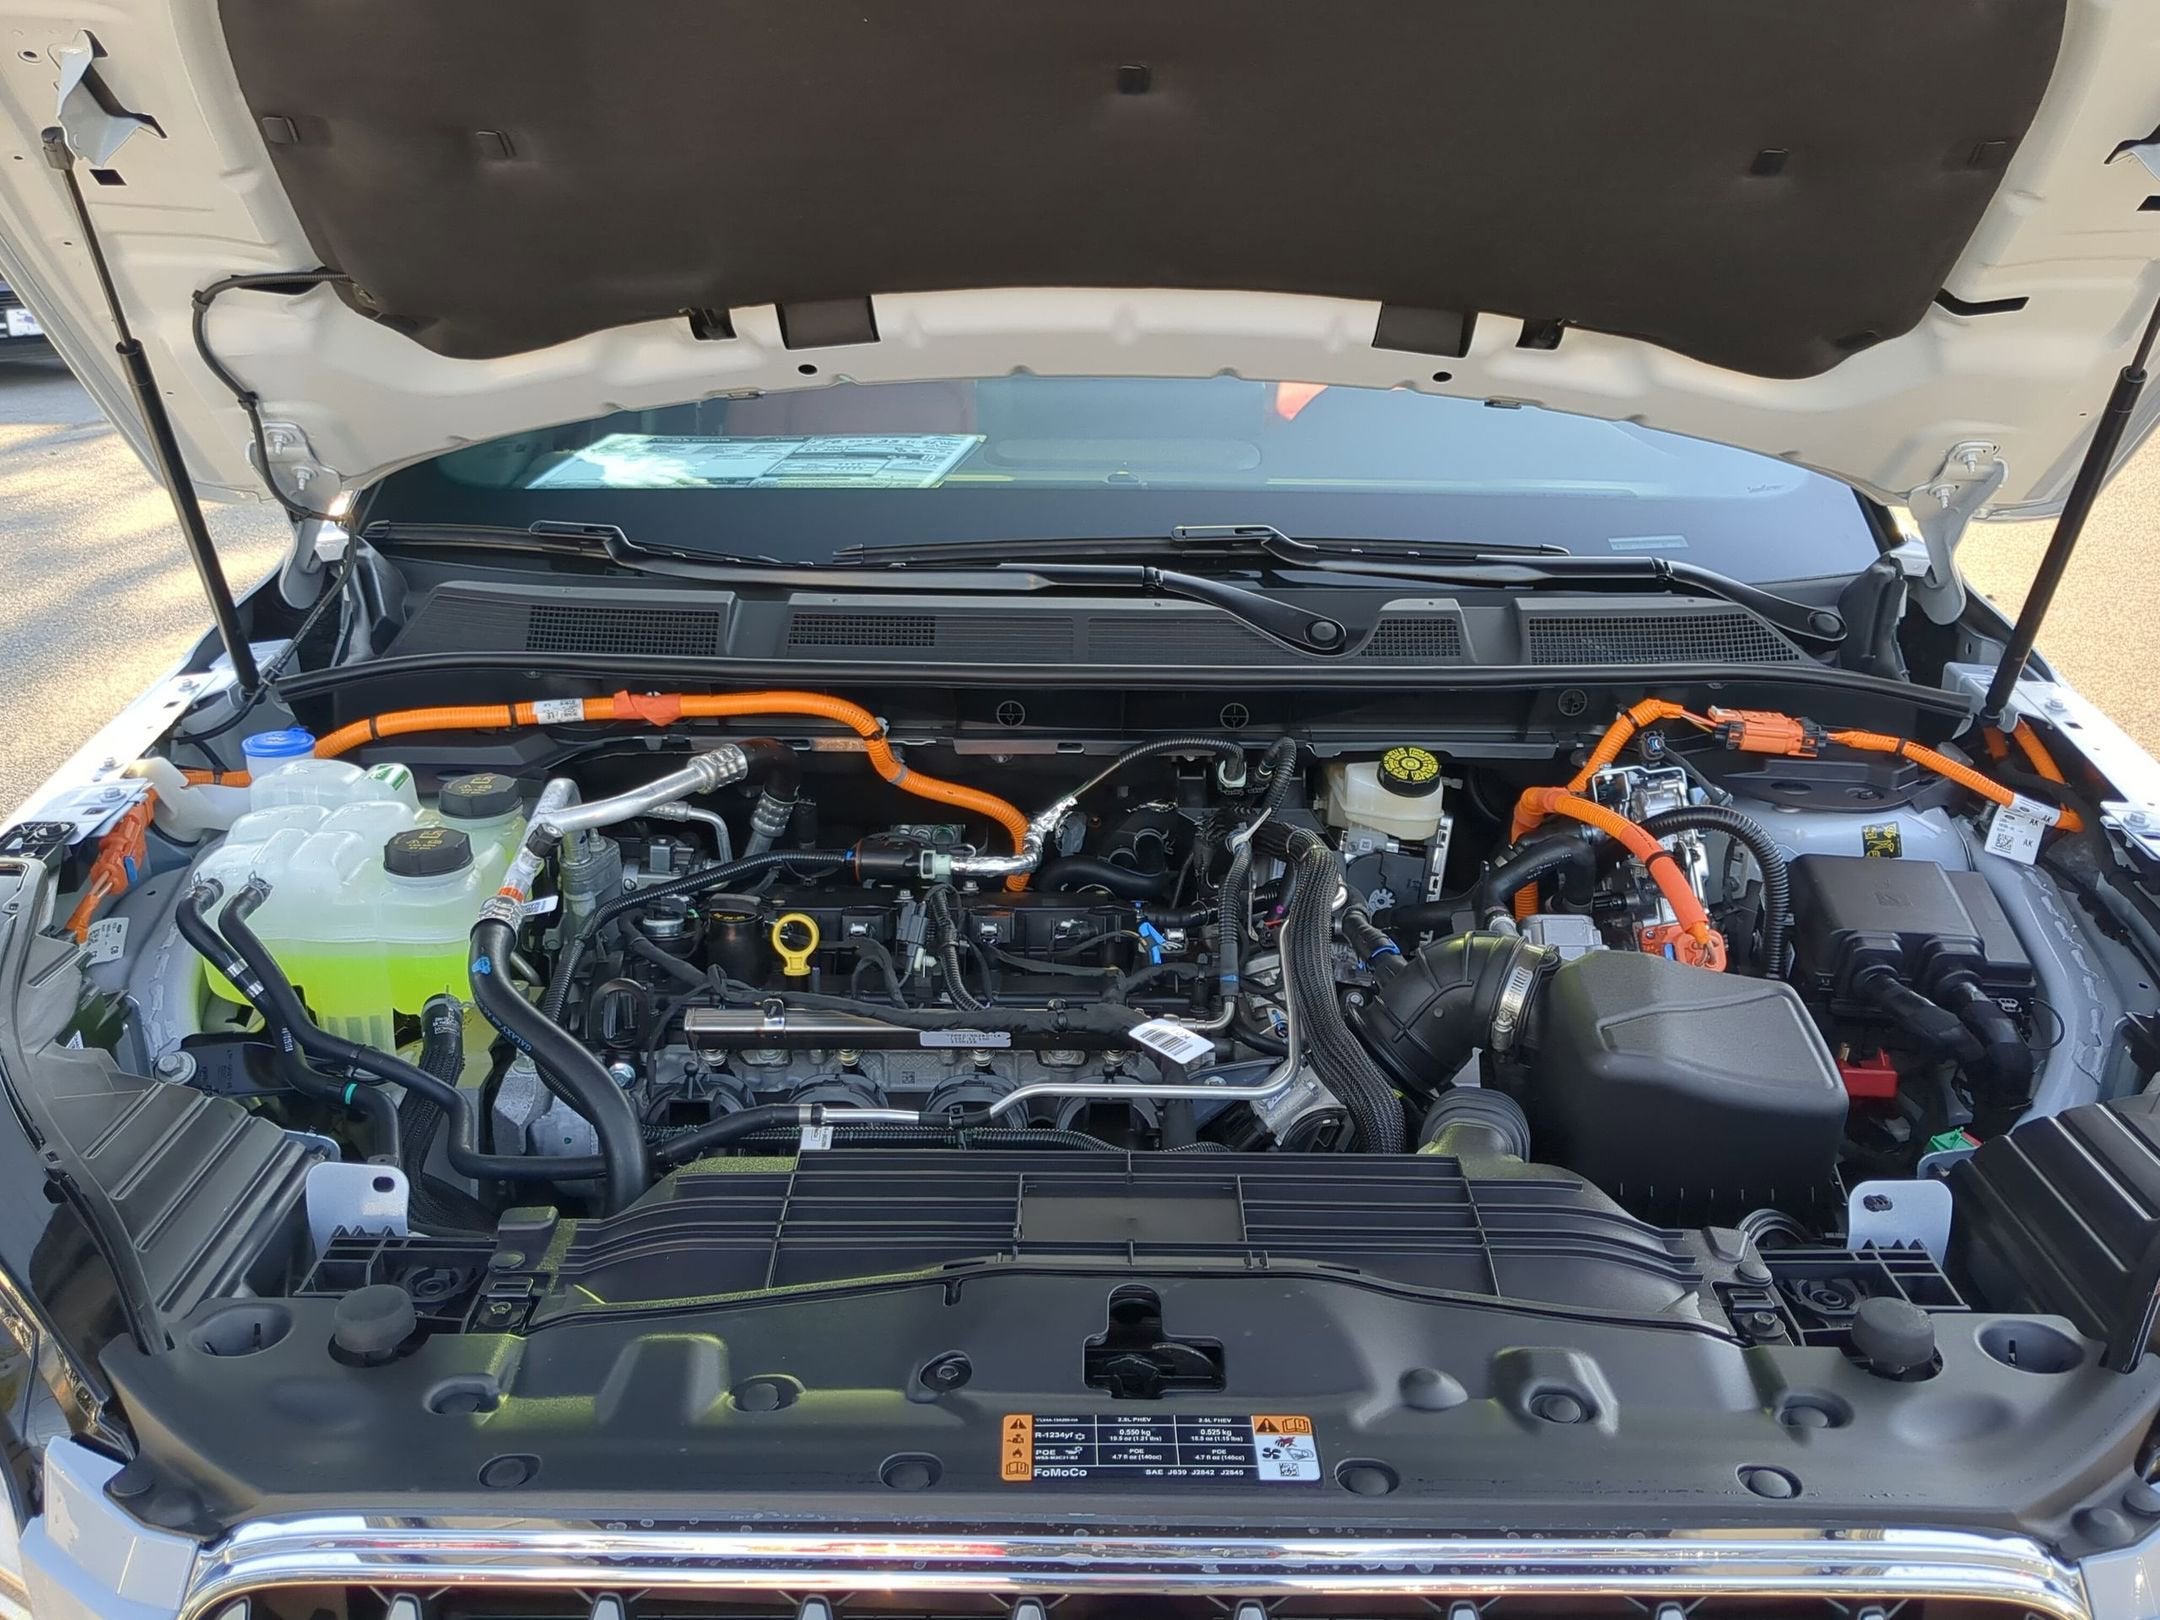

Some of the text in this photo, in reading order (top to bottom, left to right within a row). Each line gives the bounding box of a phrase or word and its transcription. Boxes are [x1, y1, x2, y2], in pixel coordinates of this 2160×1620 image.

[2029, 818, 2038, 826] AK
[2023, 839, 2033, 847] AK
[1141, 1429, 1151, 1437] kg
[1222, 1429, 1232, 1437] kg
[1034, 1468, 1088, 1477] FoMoCo
